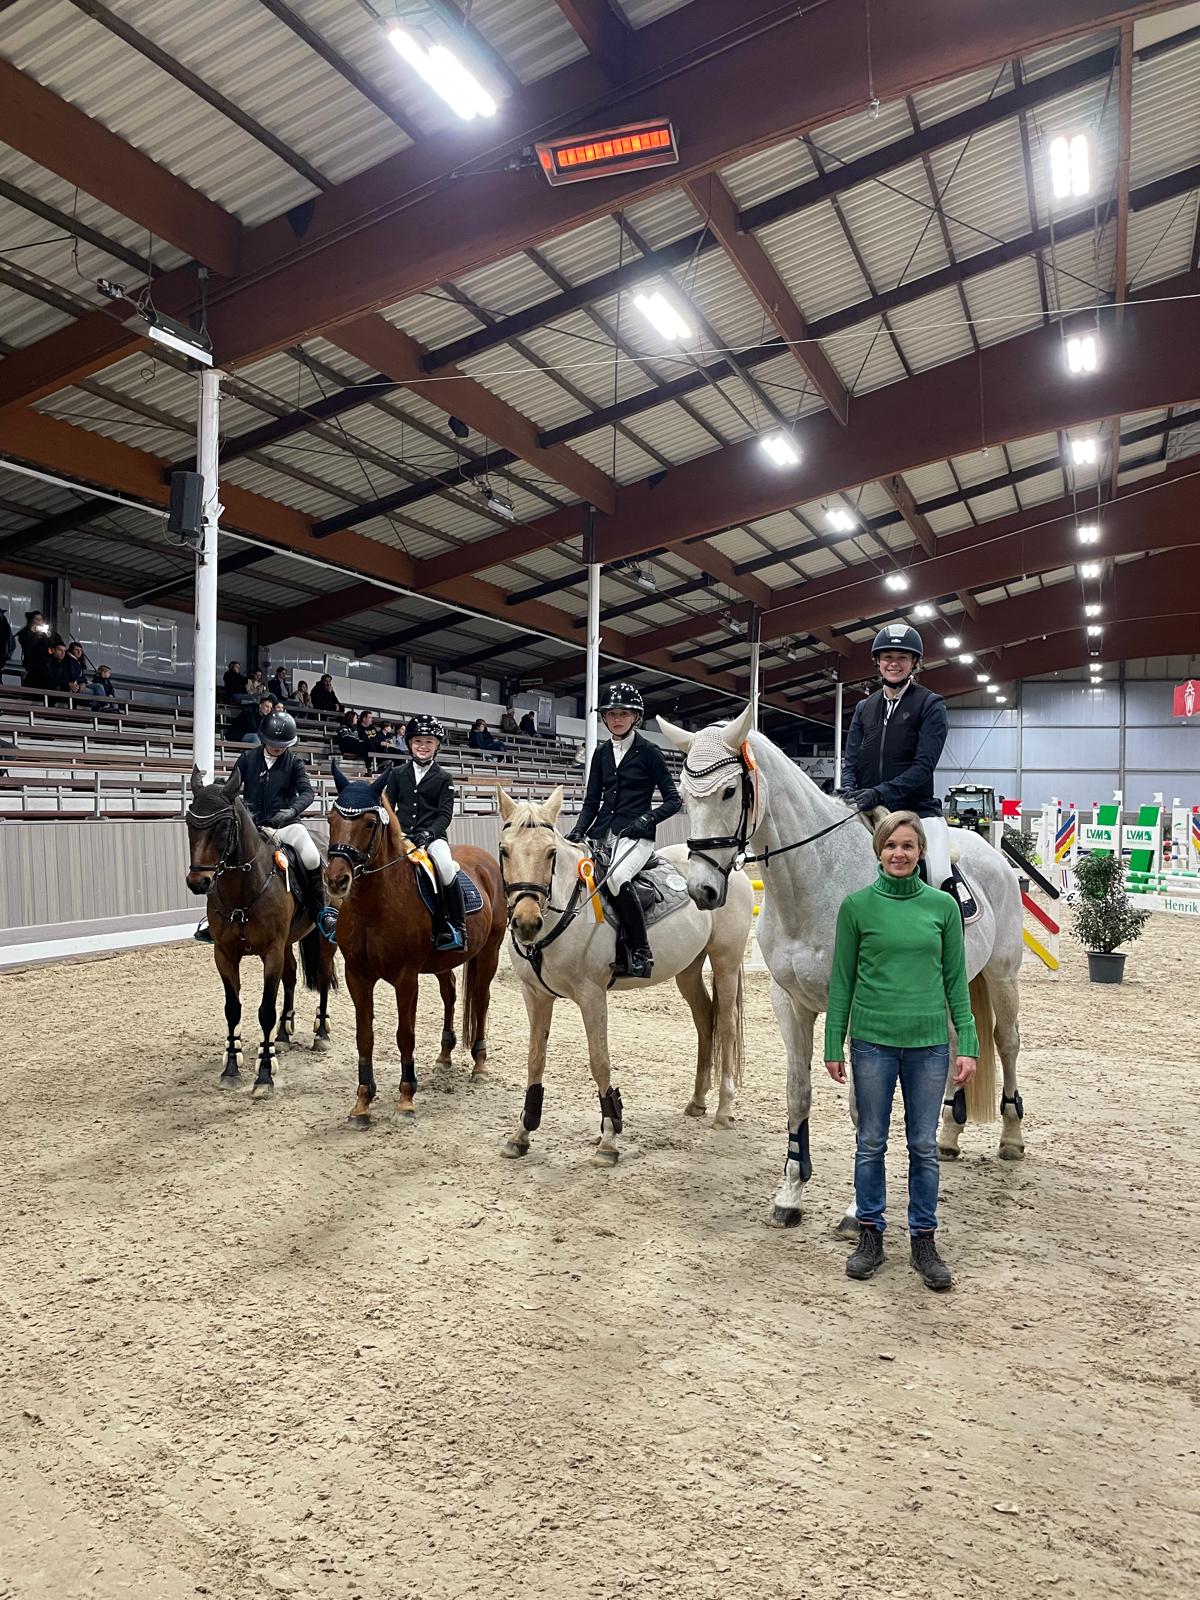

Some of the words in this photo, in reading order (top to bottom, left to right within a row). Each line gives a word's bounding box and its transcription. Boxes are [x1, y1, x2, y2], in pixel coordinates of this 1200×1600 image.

[1086, 828, 1104, 840] LVM
[1126, 830, 1144, 841] LVM
[1066, 893, 1076, 902] 6
[1165, 899, 1199, 913] Henrik
